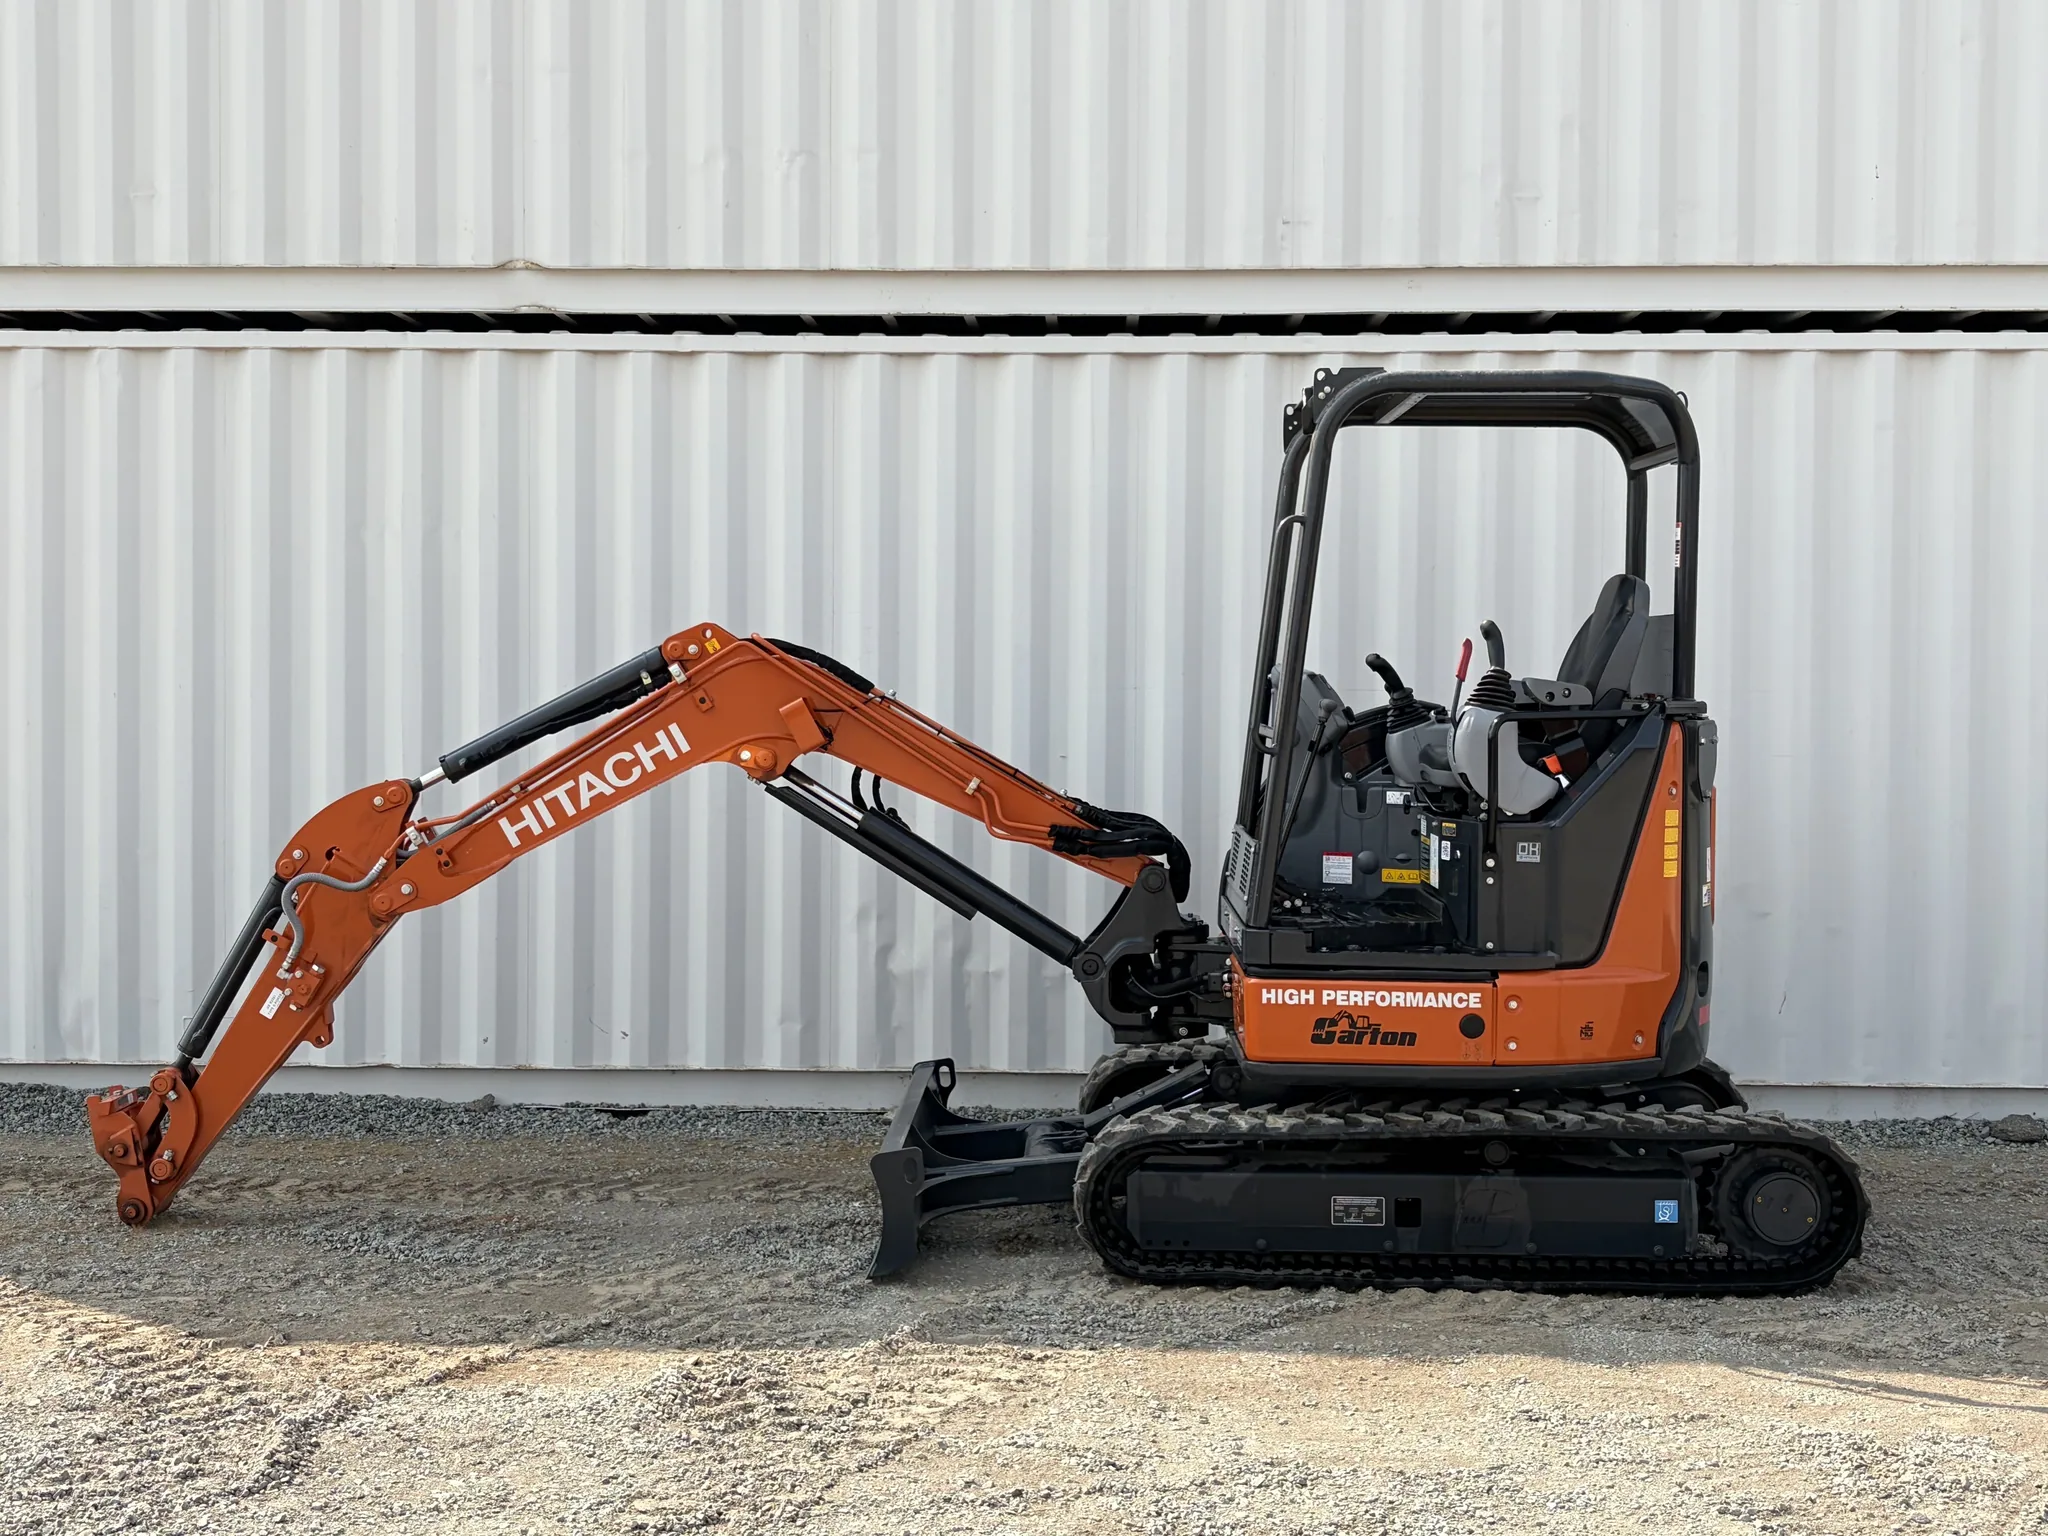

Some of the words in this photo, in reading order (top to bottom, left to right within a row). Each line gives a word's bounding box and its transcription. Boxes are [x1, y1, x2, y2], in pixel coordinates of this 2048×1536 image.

[498, 722, 691, 848] HITACHI
[1261, 988, 1314, 1005] HIGH
[1322, 990, 1482, 1008] PERFORMANCE
